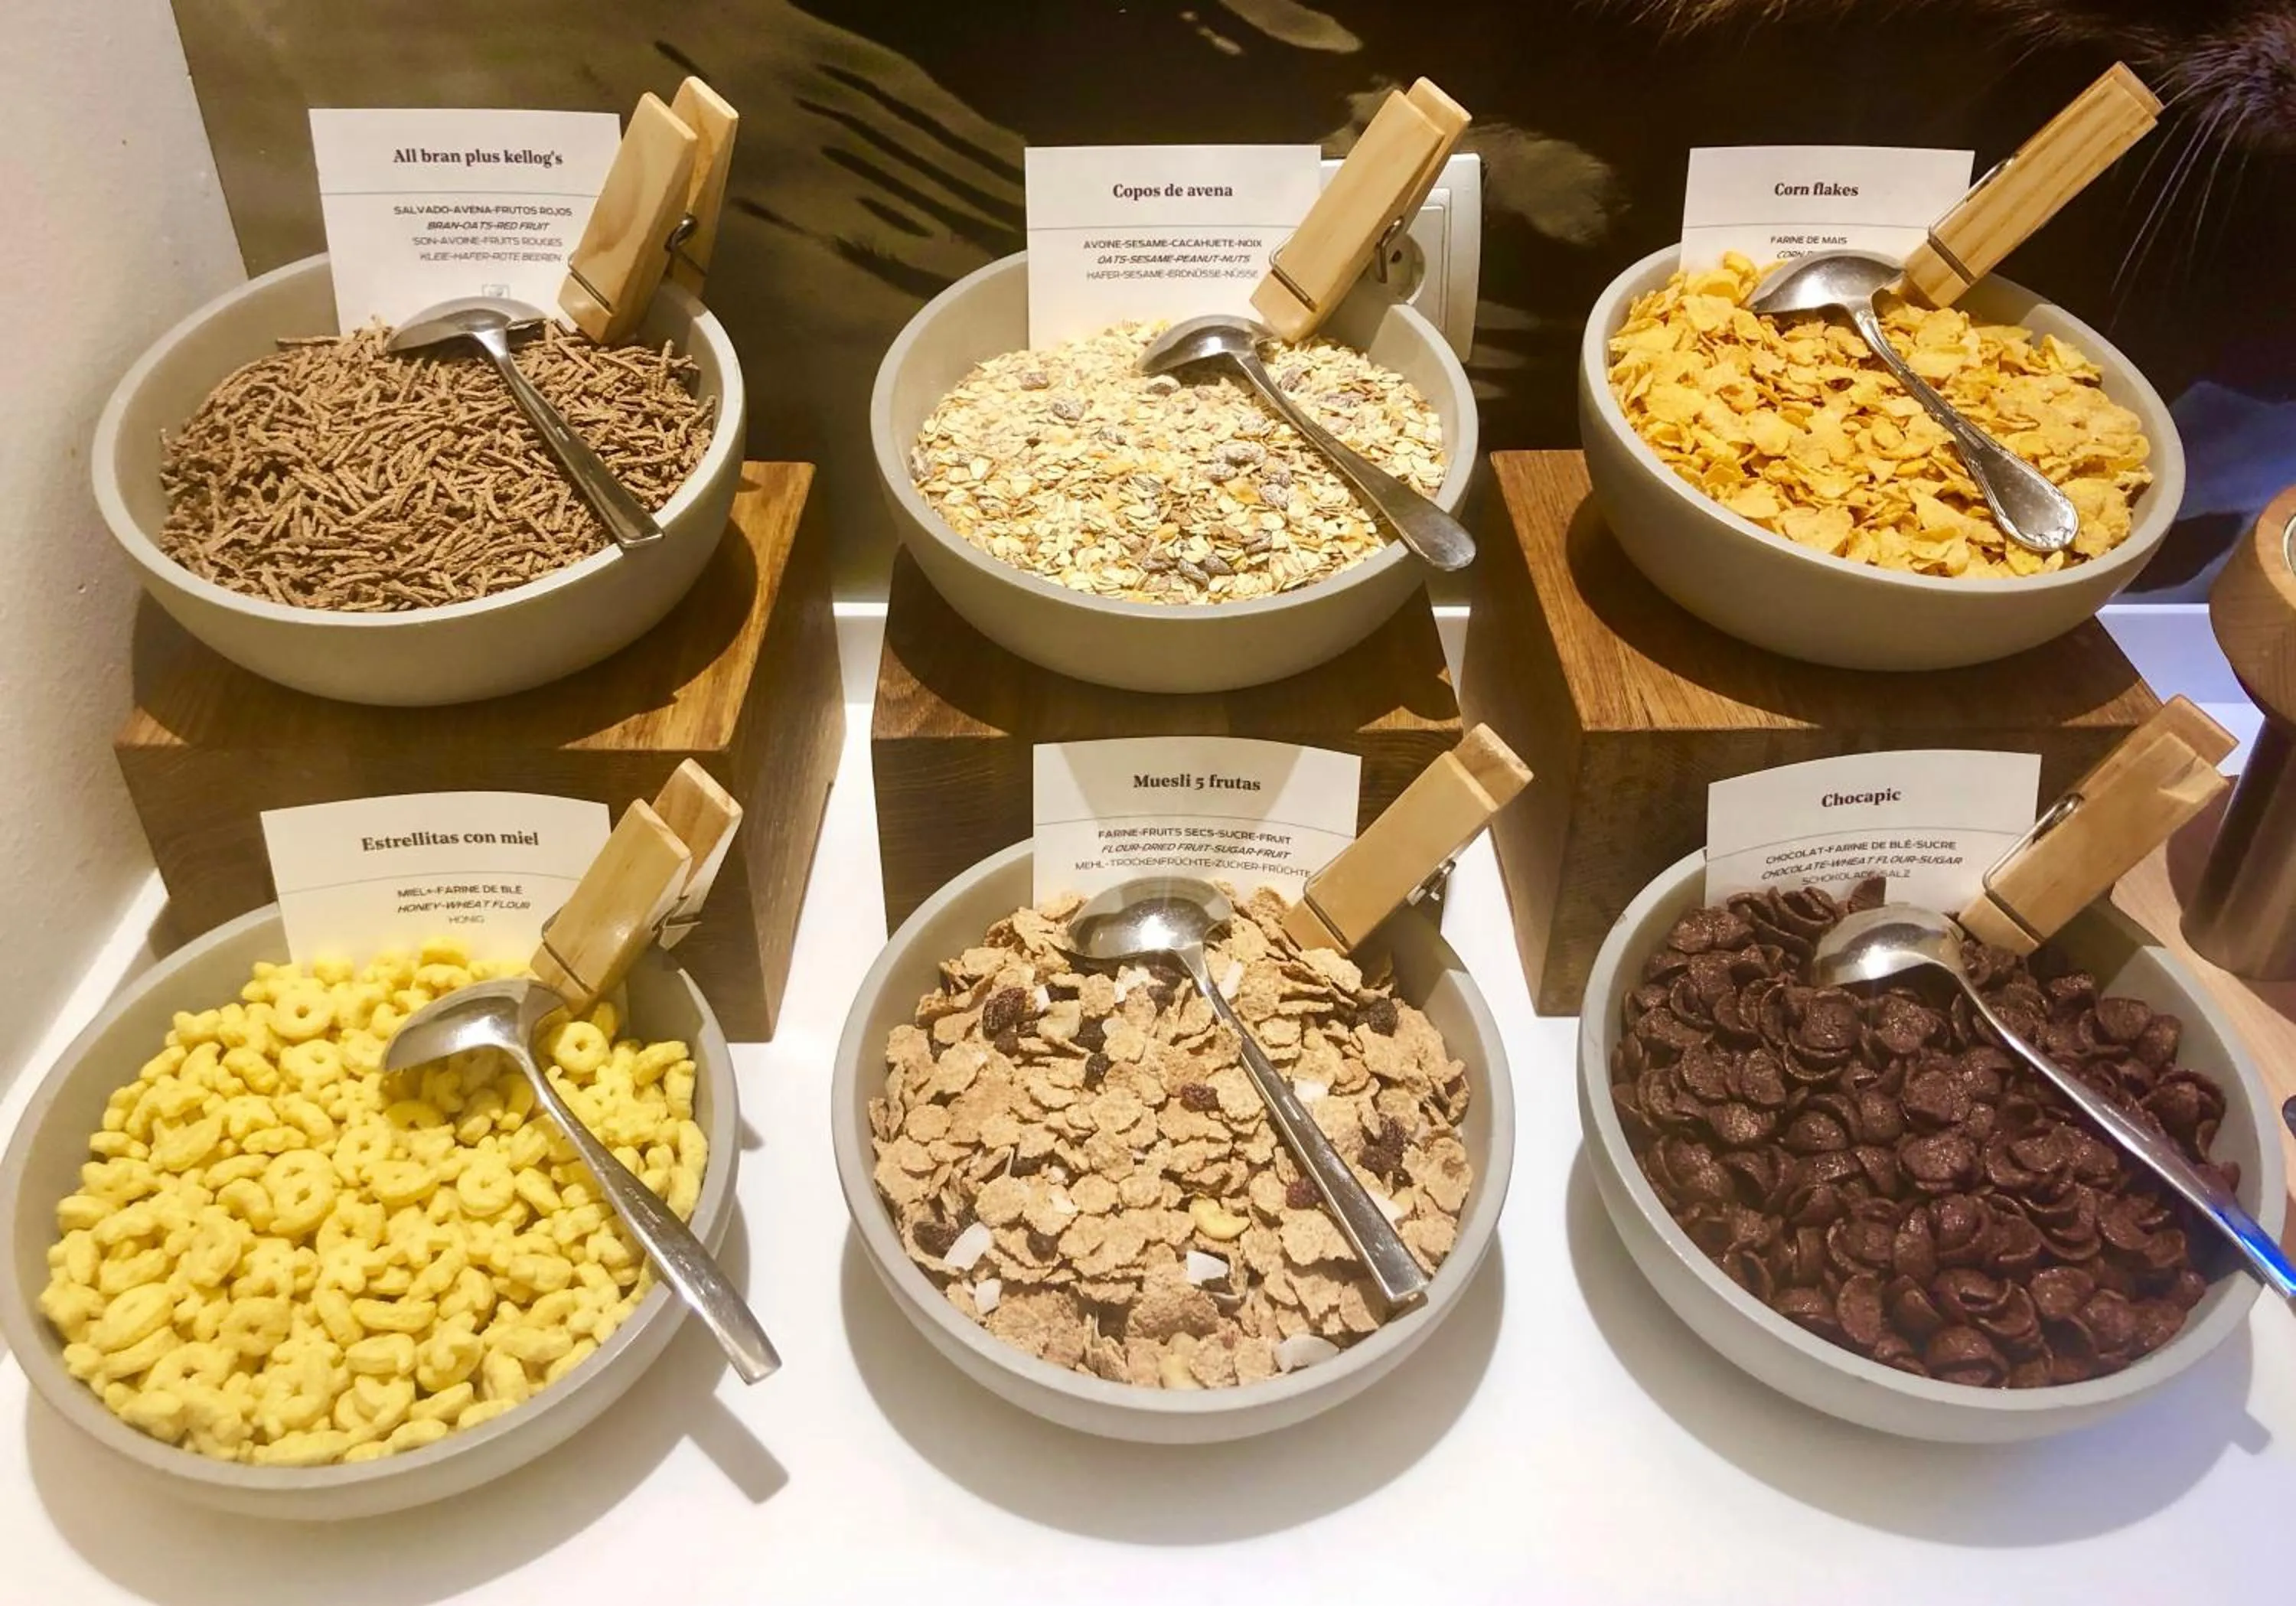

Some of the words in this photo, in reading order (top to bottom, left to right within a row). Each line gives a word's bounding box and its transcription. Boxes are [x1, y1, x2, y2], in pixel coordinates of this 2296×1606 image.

[393, 149, 418, 163] All
[421, 149, 461, 163] bran
[465, 149, 501, 167] plus
[504, 150, 563, 168] kellog's
[1112, 183, 1162, 201] Copos
[1164, 184, 1184, 197] de
[1186, 185, 1234, 197] avena
[1774, 182, 1810, 197] Corn
[1813, 181, 1859, 197] flakes
[393, 205, 537, 215] SALVADO-AVENA-FRUTOS
[539, 207, 573, 216] ROJOS
[427, 221, 518, 230] BRAN-OATS-RED
[519, 222, 550, 230] FRUIT
[413, 237, 520, 246] SON-AVOINE-FRUITS
[521, 237, 563, 247] ROUGES
[1084, 238, 1262, 249] AVOINE-SESAME-CACAHUETE-NOIX
[1770, 236, 1804, 244] FARINE
[1806, 236, 1820, 244] DE
[521, 253, 561, 262] BEEREN
[1097, 253, 1251, 264] OATS-SESAME-PEANUT-NUTS
[1133, 774, 1191, 788] Muesli
[1194, 776, 1205, 791] 5
[1208, 775, 1261, 791] frutas
[1821, 788, 1903, 808] Chocapic
[361, 831, 460, 852] Estrellitas
[463, 834, 496, 844] con
[500, 831, 540, 846] miel
[1098, 828, 1182, 839] FARINE-FRUITS
[1184, 828, 1292, 845] SECS-SUCRE-FRUIT
[1101, 843, 1176, 854] FLOUR-DRIED
[1177, 843, 1292, 859] FRUIT-SUGAR-FRUIT
[1766, 841, 1868, 864] CHOCOLAT-FARINE
[1870, 841, 1886, 850] DE
[1761, 857, 1874, 880] CHOCOLATE-WHEAT
[1875, 855, 1964, 865] FLOUR-SUGAR
[397, 900, 490, 913] HONEY-WHEAT
[491, 900, 531, 909] FLOUR
